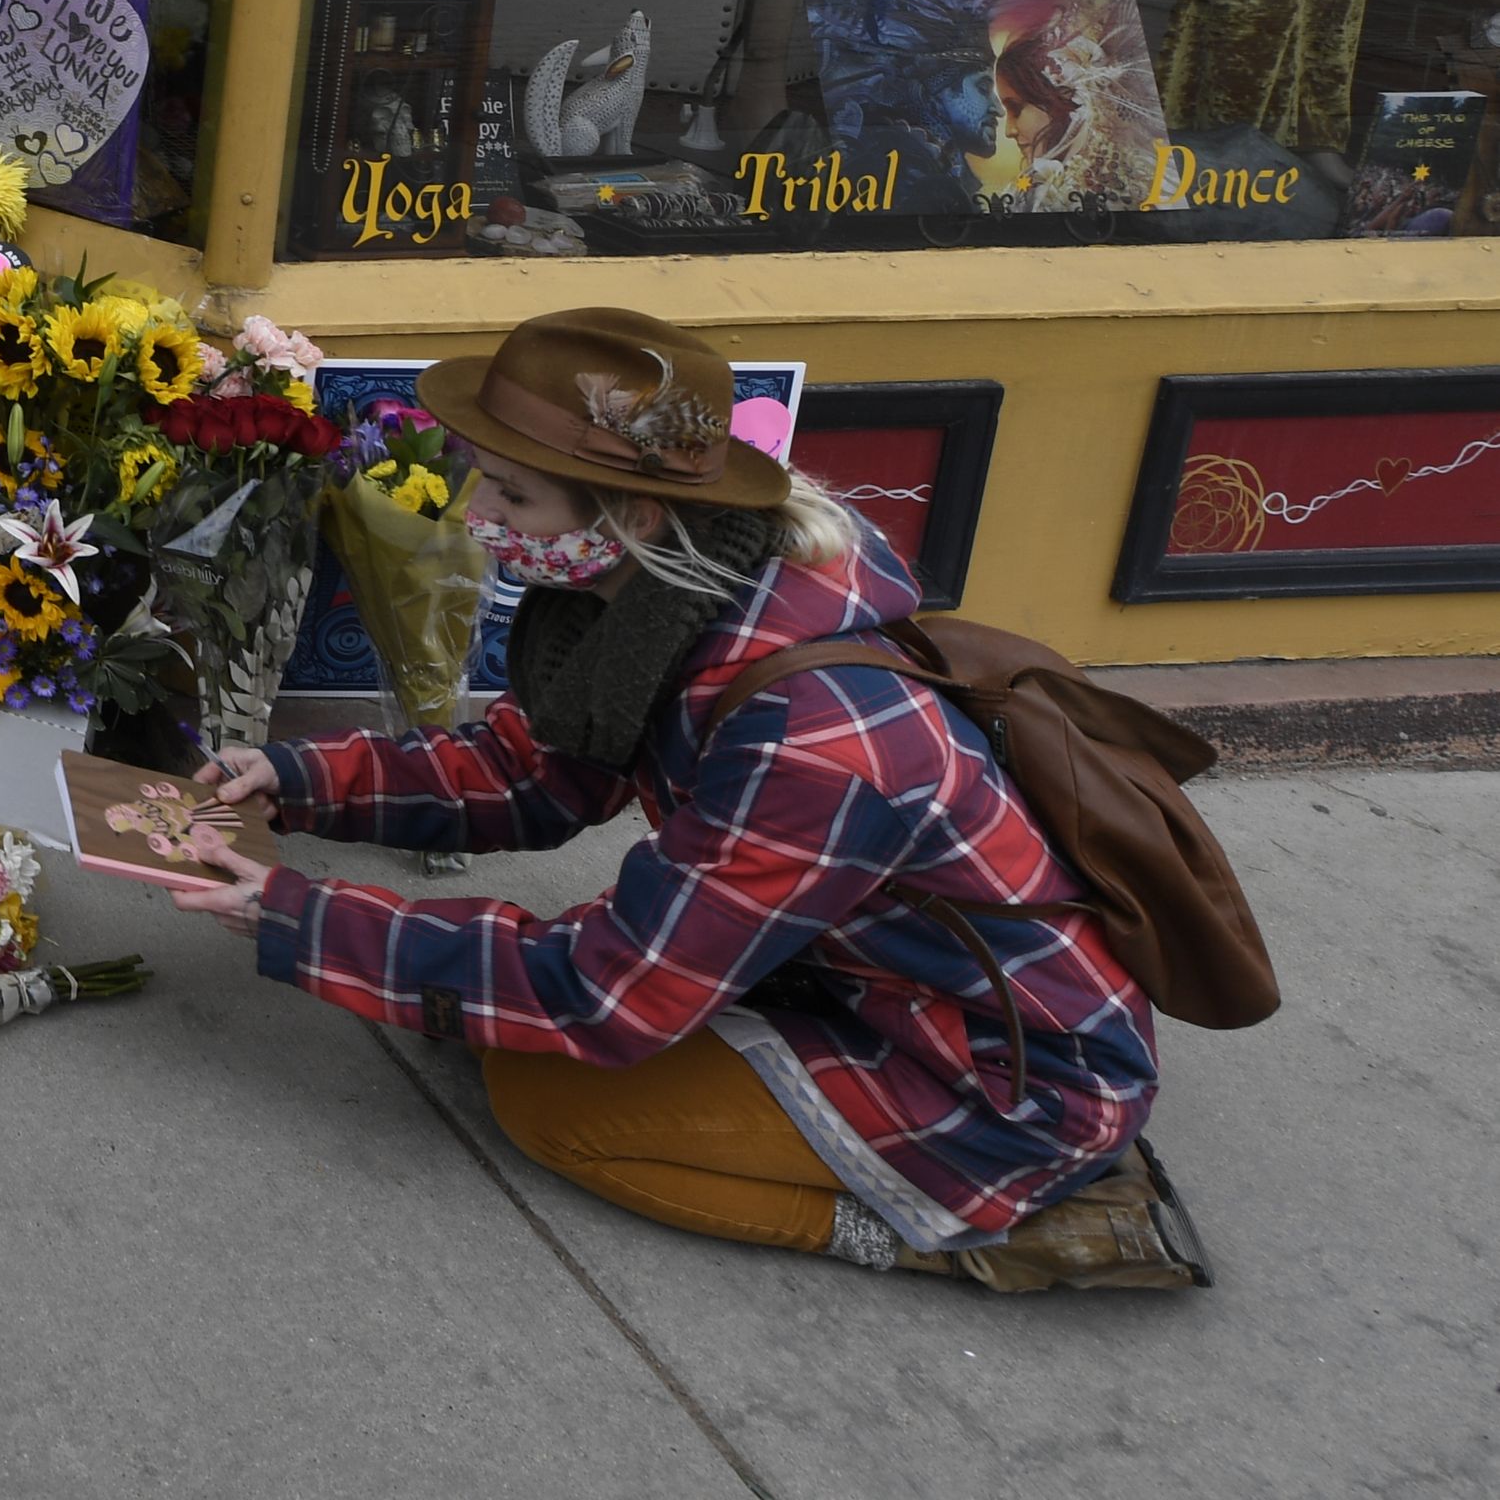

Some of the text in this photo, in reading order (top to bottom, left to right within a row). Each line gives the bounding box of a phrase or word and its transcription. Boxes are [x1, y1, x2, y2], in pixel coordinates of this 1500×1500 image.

[39, 28, 111, 110] LONNA
[1434, 113, 1466, 124] TAO
[1417, 126, 1437, 135] OF
[1395, 138, 1456, 149] CHEESE
[341, 156, 474, 247] Yoga
[735, 150, 900, 217] Tribal
[1139, 140, 1301, 211] Dance
